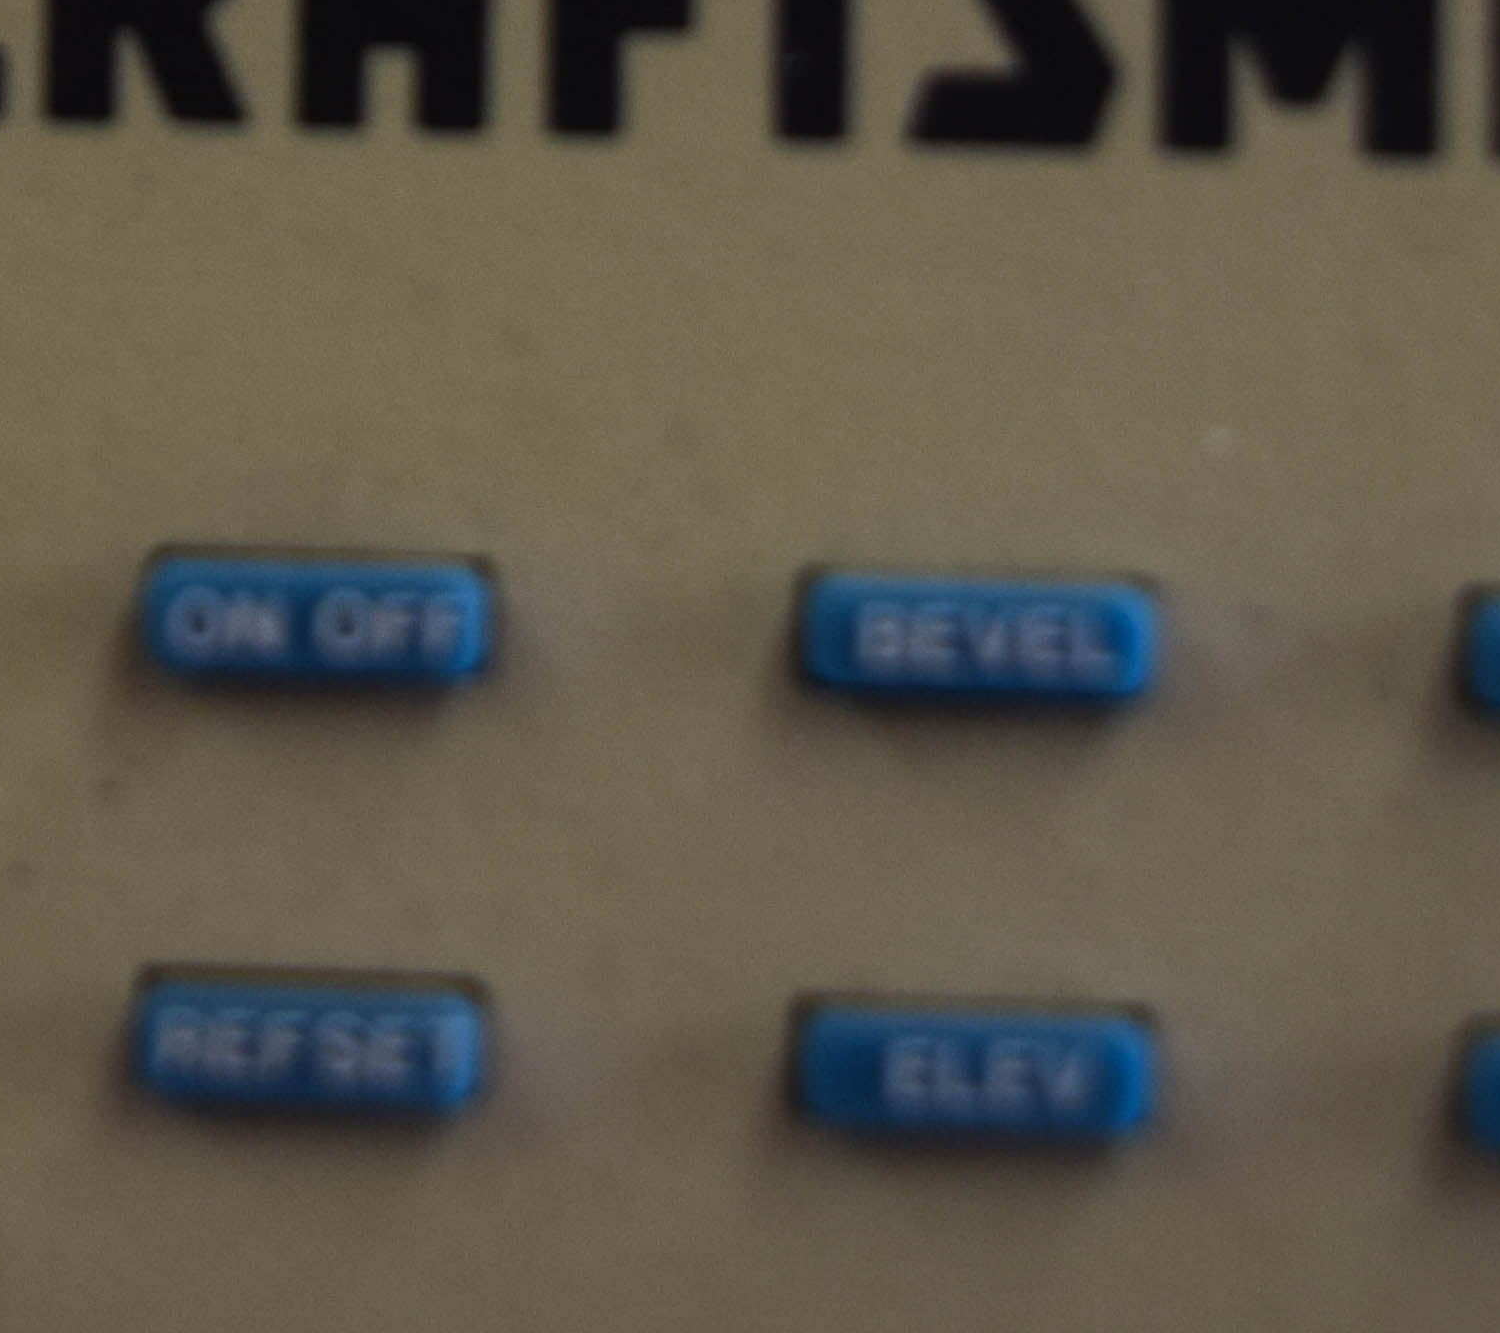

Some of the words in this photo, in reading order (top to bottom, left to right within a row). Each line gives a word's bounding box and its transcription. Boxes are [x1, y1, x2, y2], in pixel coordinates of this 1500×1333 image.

[164, 585, 288, 659] ON
[312, 587, 470, 663] OFF
[853, 597, 1115, 675] BEVEL
[880, 1035, 1098, 1115] ELEV
